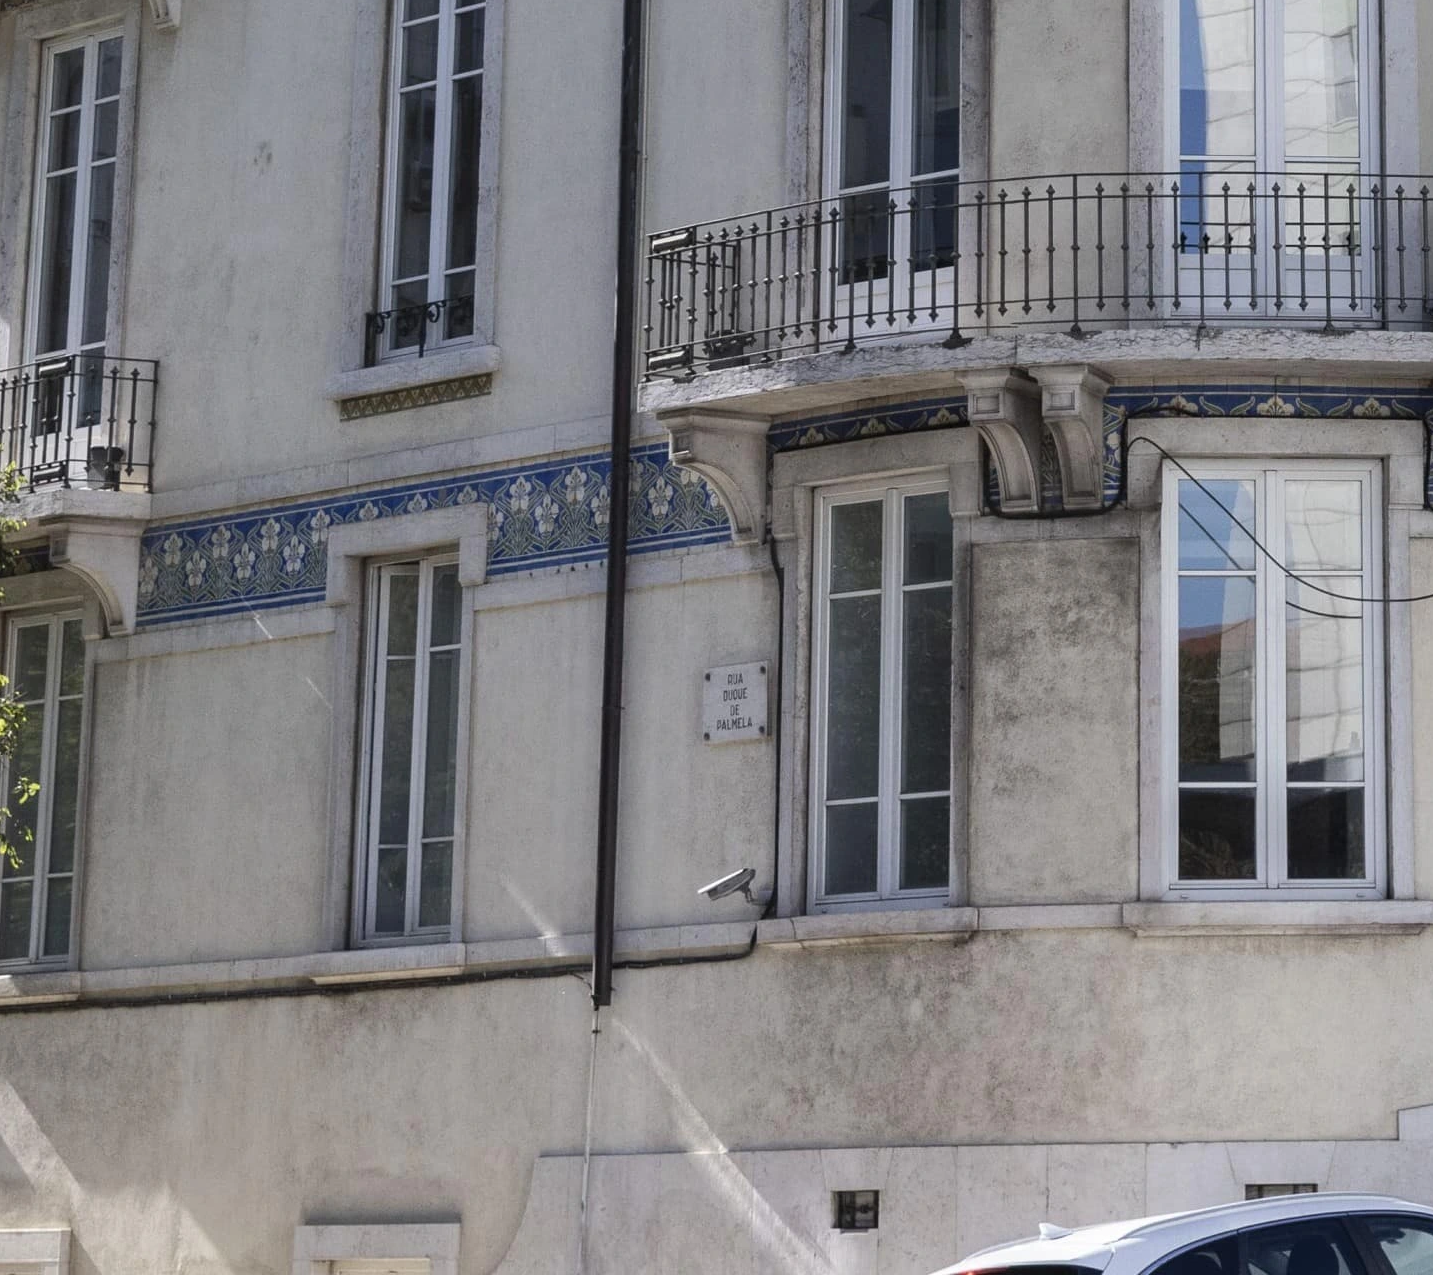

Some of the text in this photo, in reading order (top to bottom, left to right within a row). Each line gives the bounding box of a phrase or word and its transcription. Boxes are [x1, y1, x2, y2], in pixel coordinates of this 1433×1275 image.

[727, 673, 744, 686] RUA
[730, 704, 740, 716] DE
[716, 717, 753, 731] PALMELA
